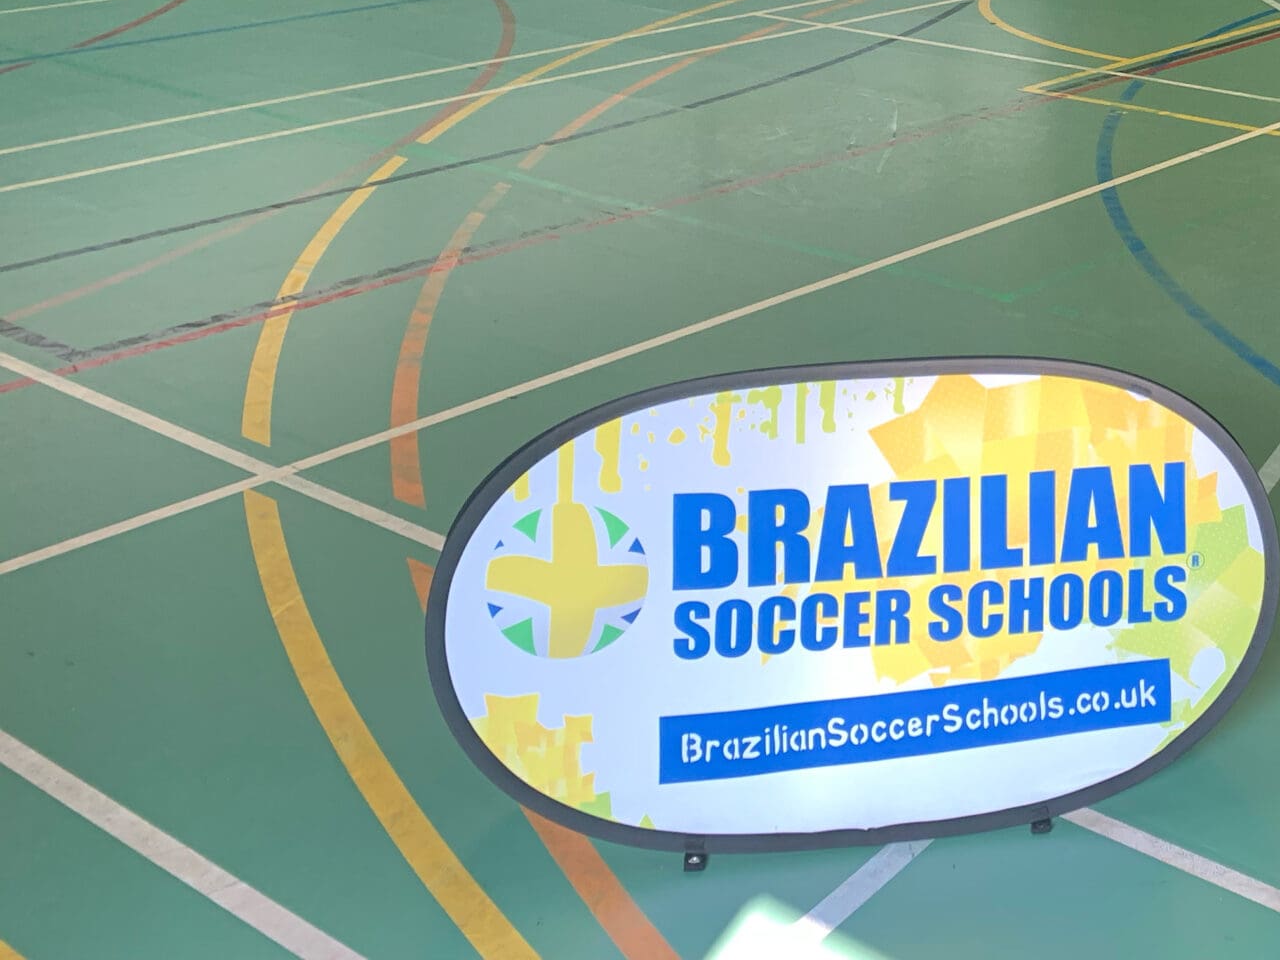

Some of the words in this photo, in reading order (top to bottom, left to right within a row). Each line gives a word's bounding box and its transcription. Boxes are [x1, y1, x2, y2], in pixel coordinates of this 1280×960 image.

[672, 462, 1186, 591] BRAZILIAN
[673, 590, 911, 660] SOCCER
[928, 565, 1187, 641] SCHOOLS
[681, 679, 1157, 763] BrazilianSoccerSchools.co.uk
